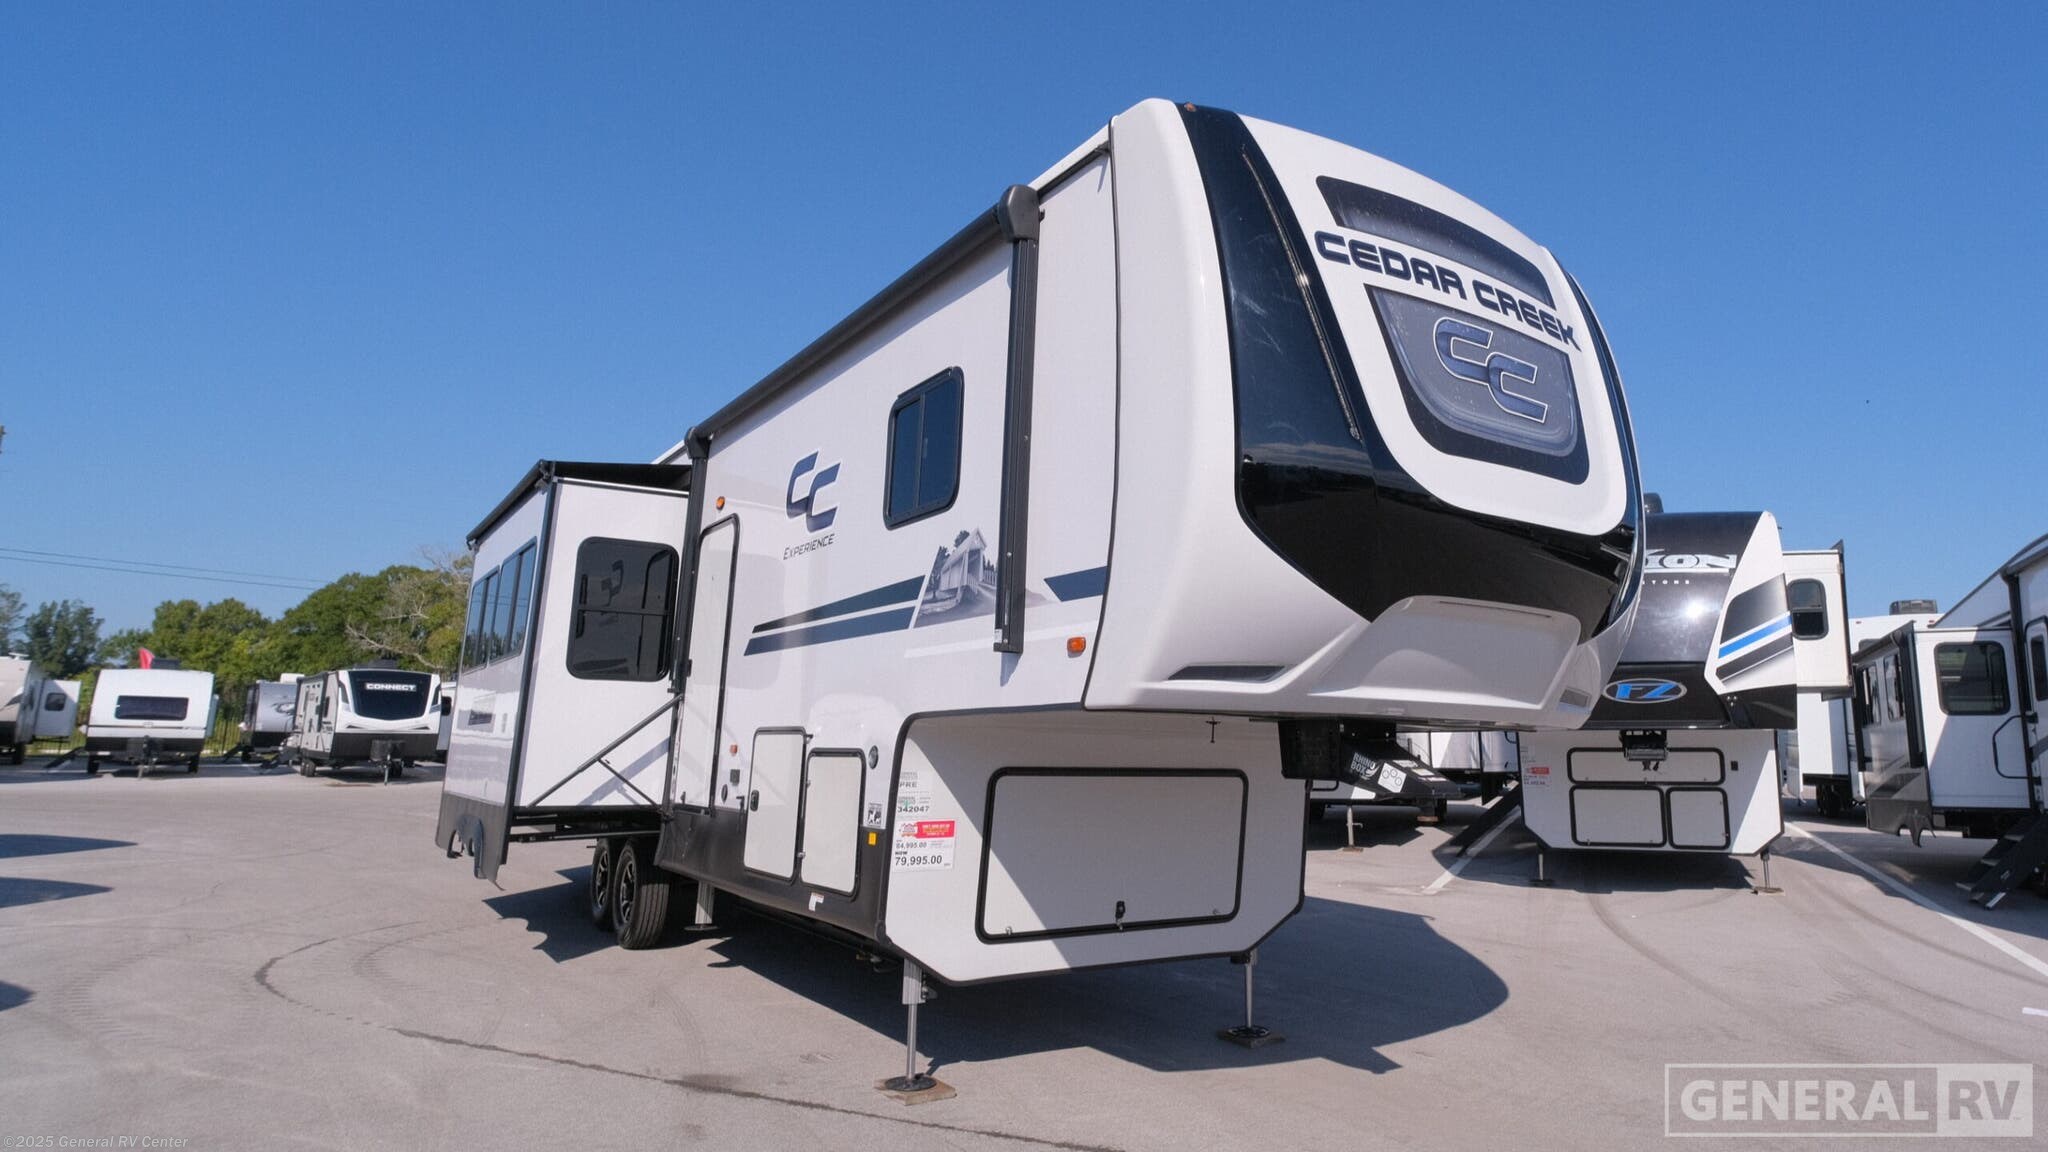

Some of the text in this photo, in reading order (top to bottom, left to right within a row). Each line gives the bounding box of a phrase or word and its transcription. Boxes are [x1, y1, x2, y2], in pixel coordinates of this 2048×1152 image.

[1315, 229, 1582, 353] CEDAR CREEK
[1433, 317, 1548, 424] CC
[786, 450, 842, 533] CC
[366, 683, 416, 691] CONNECT
[1615, 682, 1678, 699] FZ
[1350, 760, 1367, 777] BOX
[1353, 752, 1376, 770] RHINO
[897, 805, 930, 813] 342047
[895, 855, 943, 866] 79,995.00
